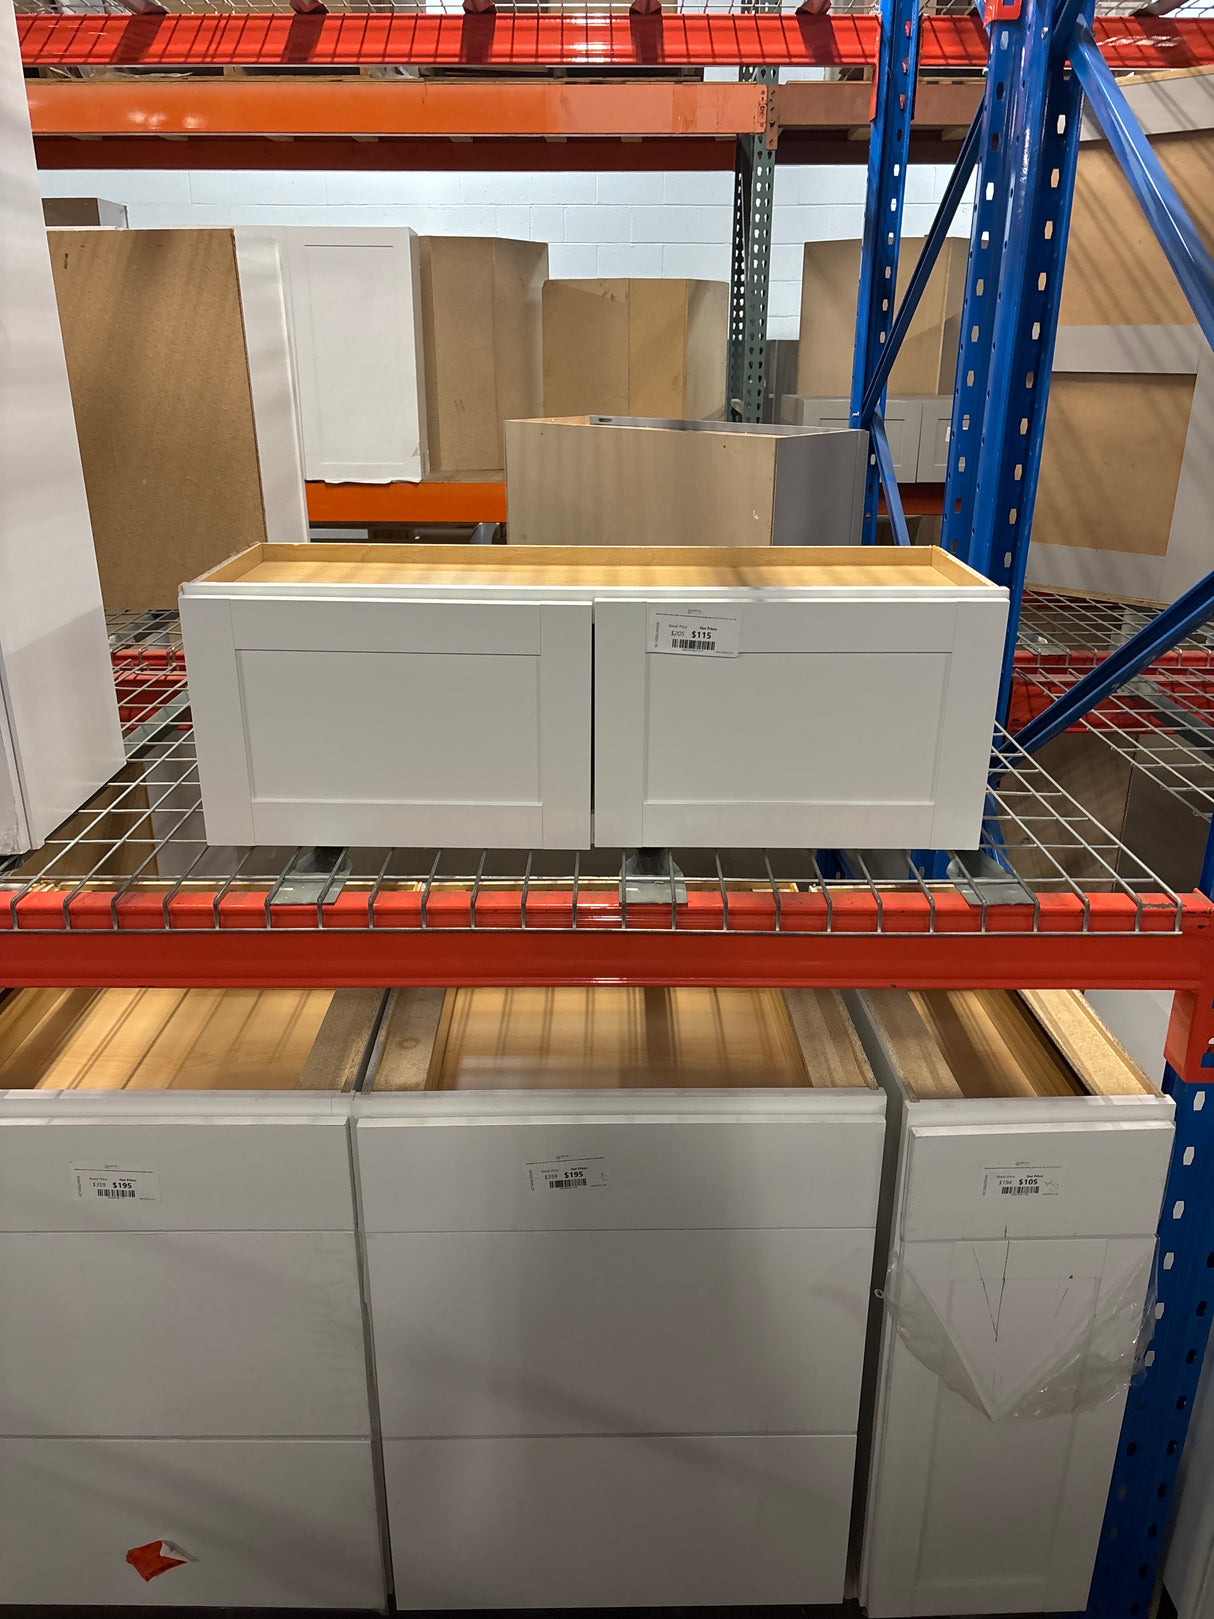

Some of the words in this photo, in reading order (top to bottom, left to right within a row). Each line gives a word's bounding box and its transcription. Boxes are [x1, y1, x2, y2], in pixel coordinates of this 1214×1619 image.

[691, 630, 712, 640] $115
[563, 1170, 584, 1179] $195
[112, 1181, 132, 1189] $195
[1018, 1178, 1038, 1186] $105
